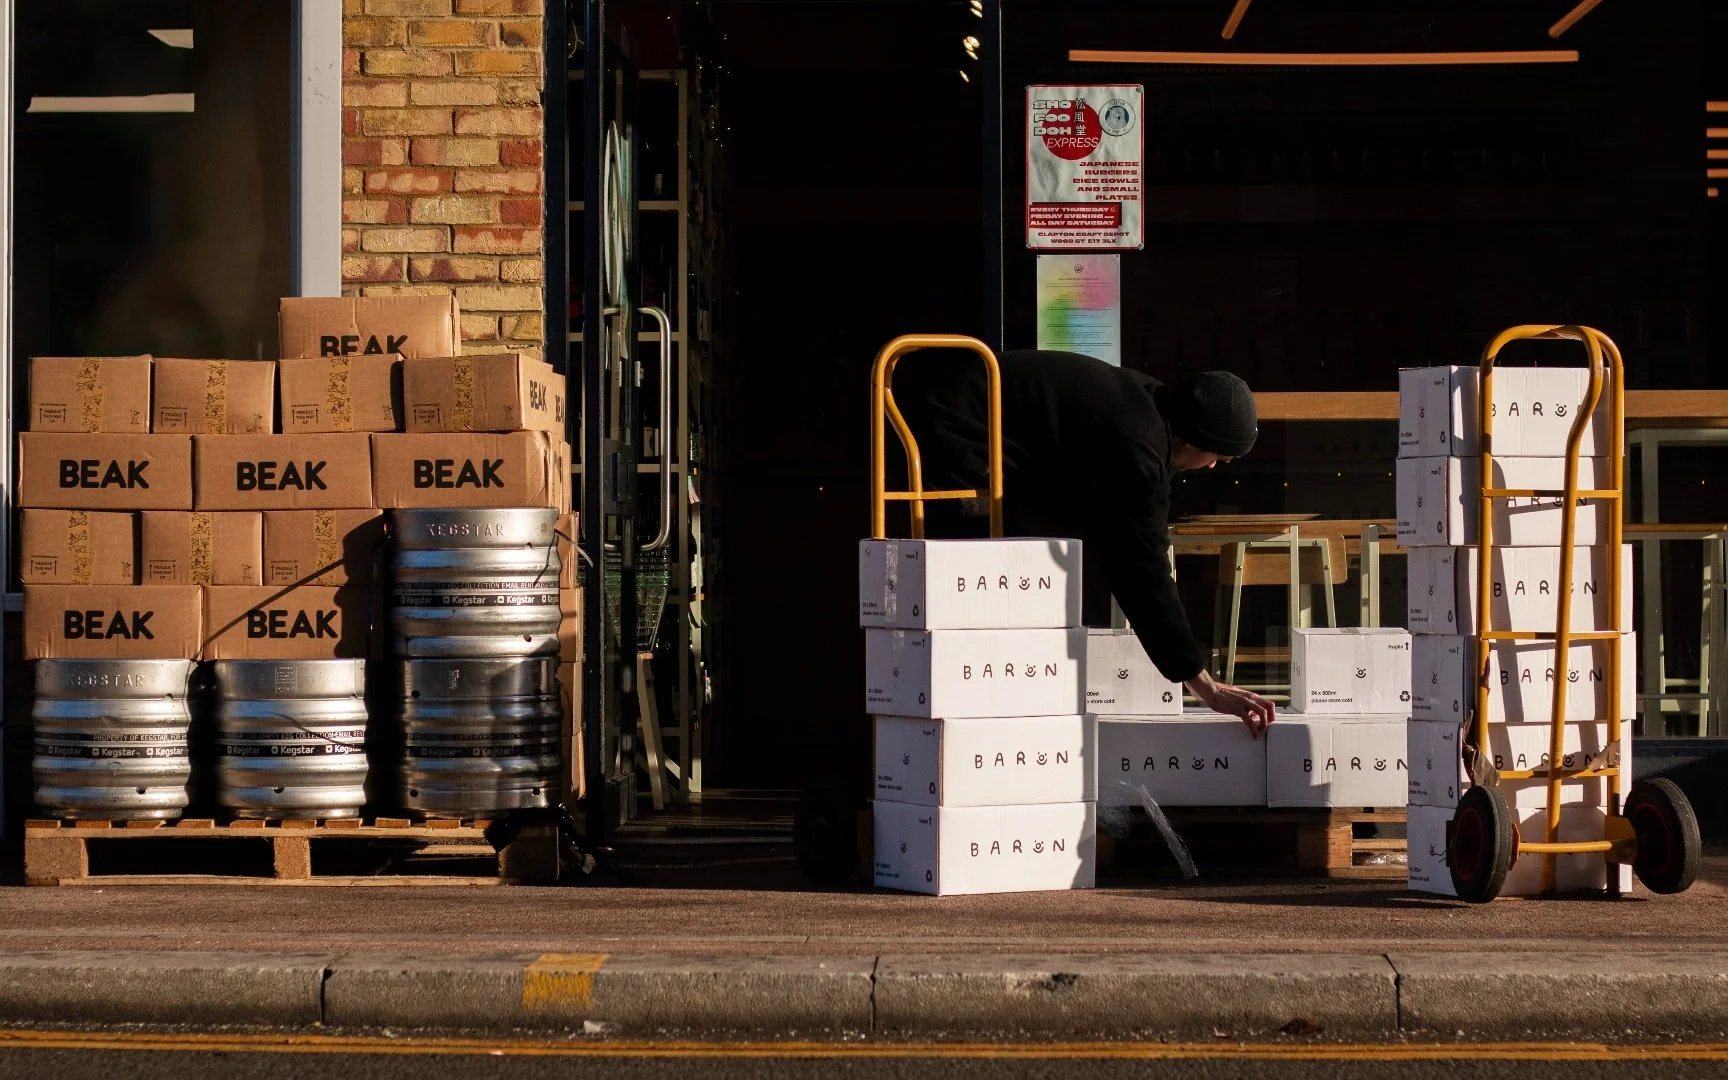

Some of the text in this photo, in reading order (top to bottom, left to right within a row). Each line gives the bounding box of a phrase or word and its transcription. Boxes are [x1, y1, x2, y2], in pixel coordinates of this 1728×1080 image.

[1033, 100, 1071, 109] SHO
[1034, 114, 1070, 123] FOO
[1034, 127, 1071, 136] DOH
[1046, 138, 1099, 148] EXPRESS
[320, 335, 408, 357] BEAK
[530, 380, 547, 412] BEAK
[60, 460, 150, 490] BEAK
[236, 460, 328, 492] BEAK
[414, 458, 504, 489] BEAK
[426, 524, 504, 536] KEGSTAR
[1494, 580, 1597, 597] BARN
[452, 596, 486, 605] Kegstar
[507, 595, 534, 604] Kegstar
[64, 610, 154, 639] BEAK
[247, 610, 338, 639] BEAK
[102, 748, 136, 756] Kegstar
[155, 747, 184, 756] Kegstar
[281, 746, 314, 755] Kegstar
